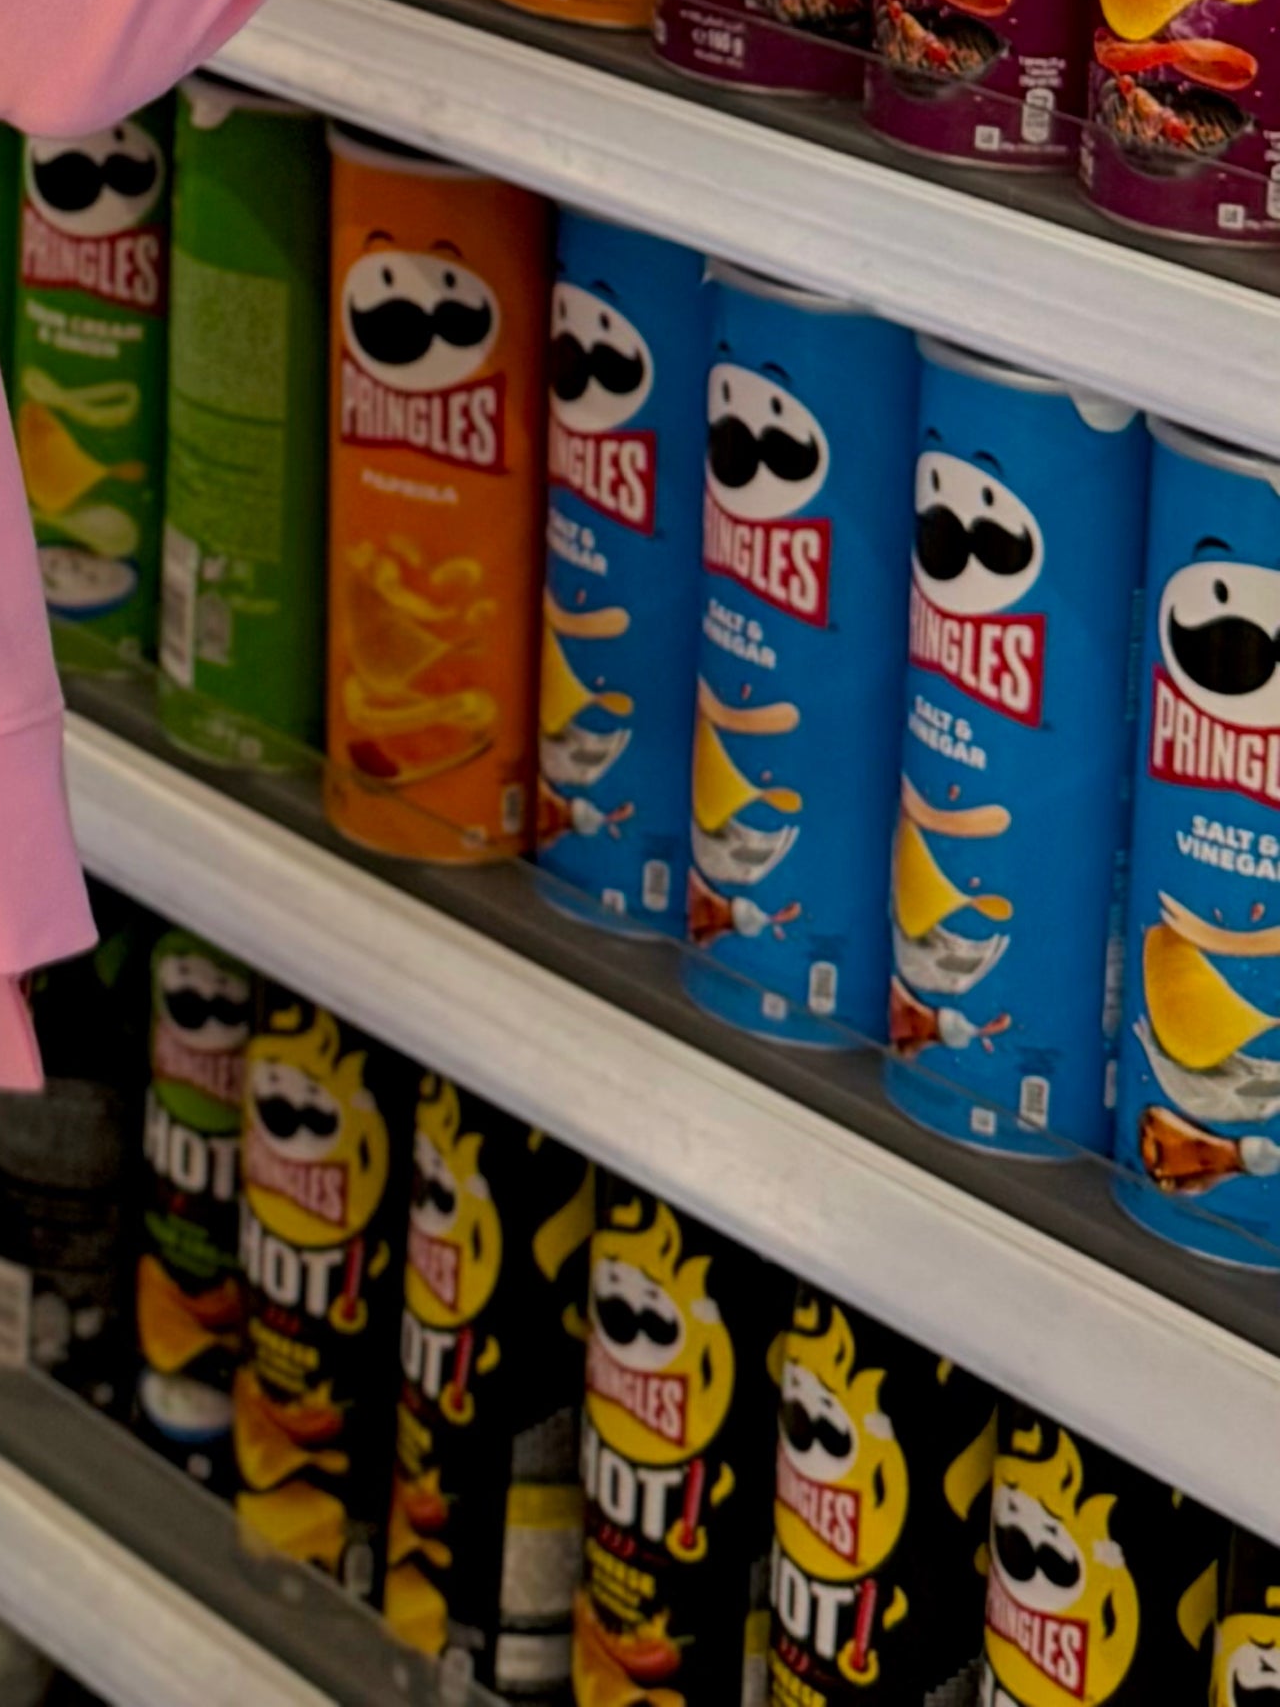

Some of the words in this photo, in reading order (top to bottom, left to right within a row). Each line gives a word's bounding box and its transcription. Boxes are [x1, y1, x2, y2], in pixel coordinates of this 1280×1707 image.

[341, 360, 498, 468] PRINGLES
[954, 716, 974, 741] &
[1191, 814, 1255, 853] SALT
[1257, 828, 1279, 859] &
